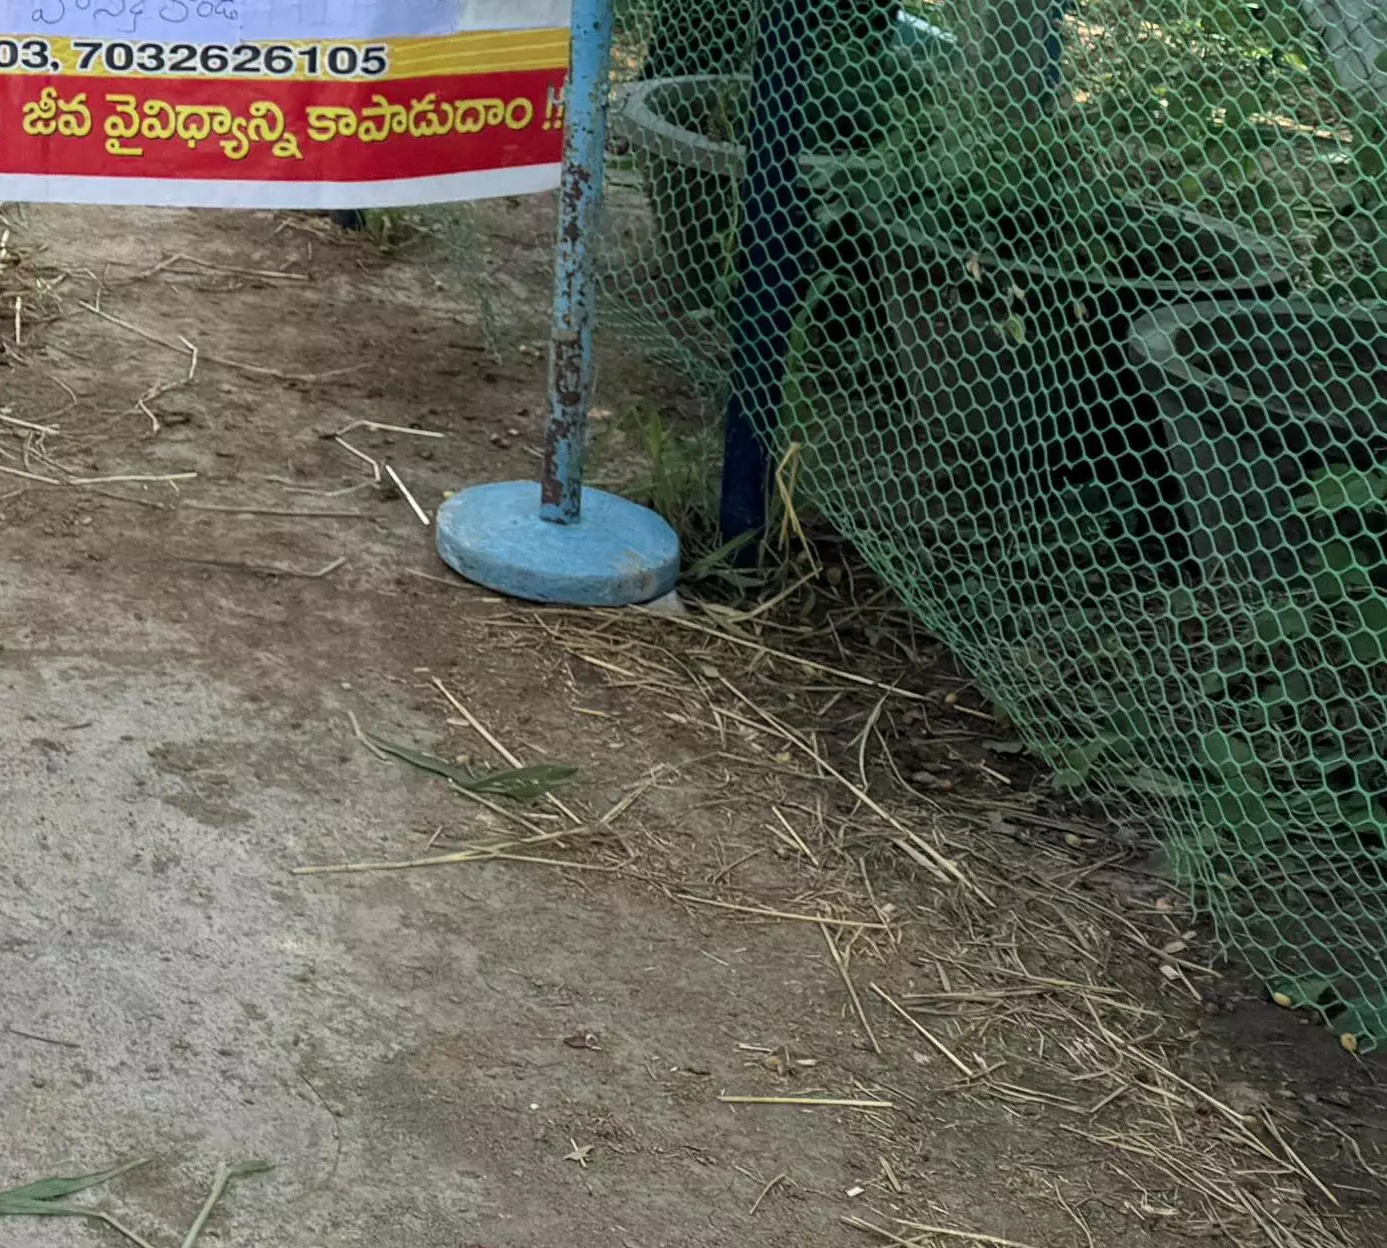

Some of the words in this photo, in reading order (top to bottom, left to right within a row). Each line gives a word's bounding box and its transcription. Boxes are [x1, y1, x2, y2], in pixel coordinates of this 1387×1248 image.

[72, 41, 388, 75] 7032626105
[22, 85, 93, 137] జీవ
[305, 92, 534, 143] కాపాడుదాం
